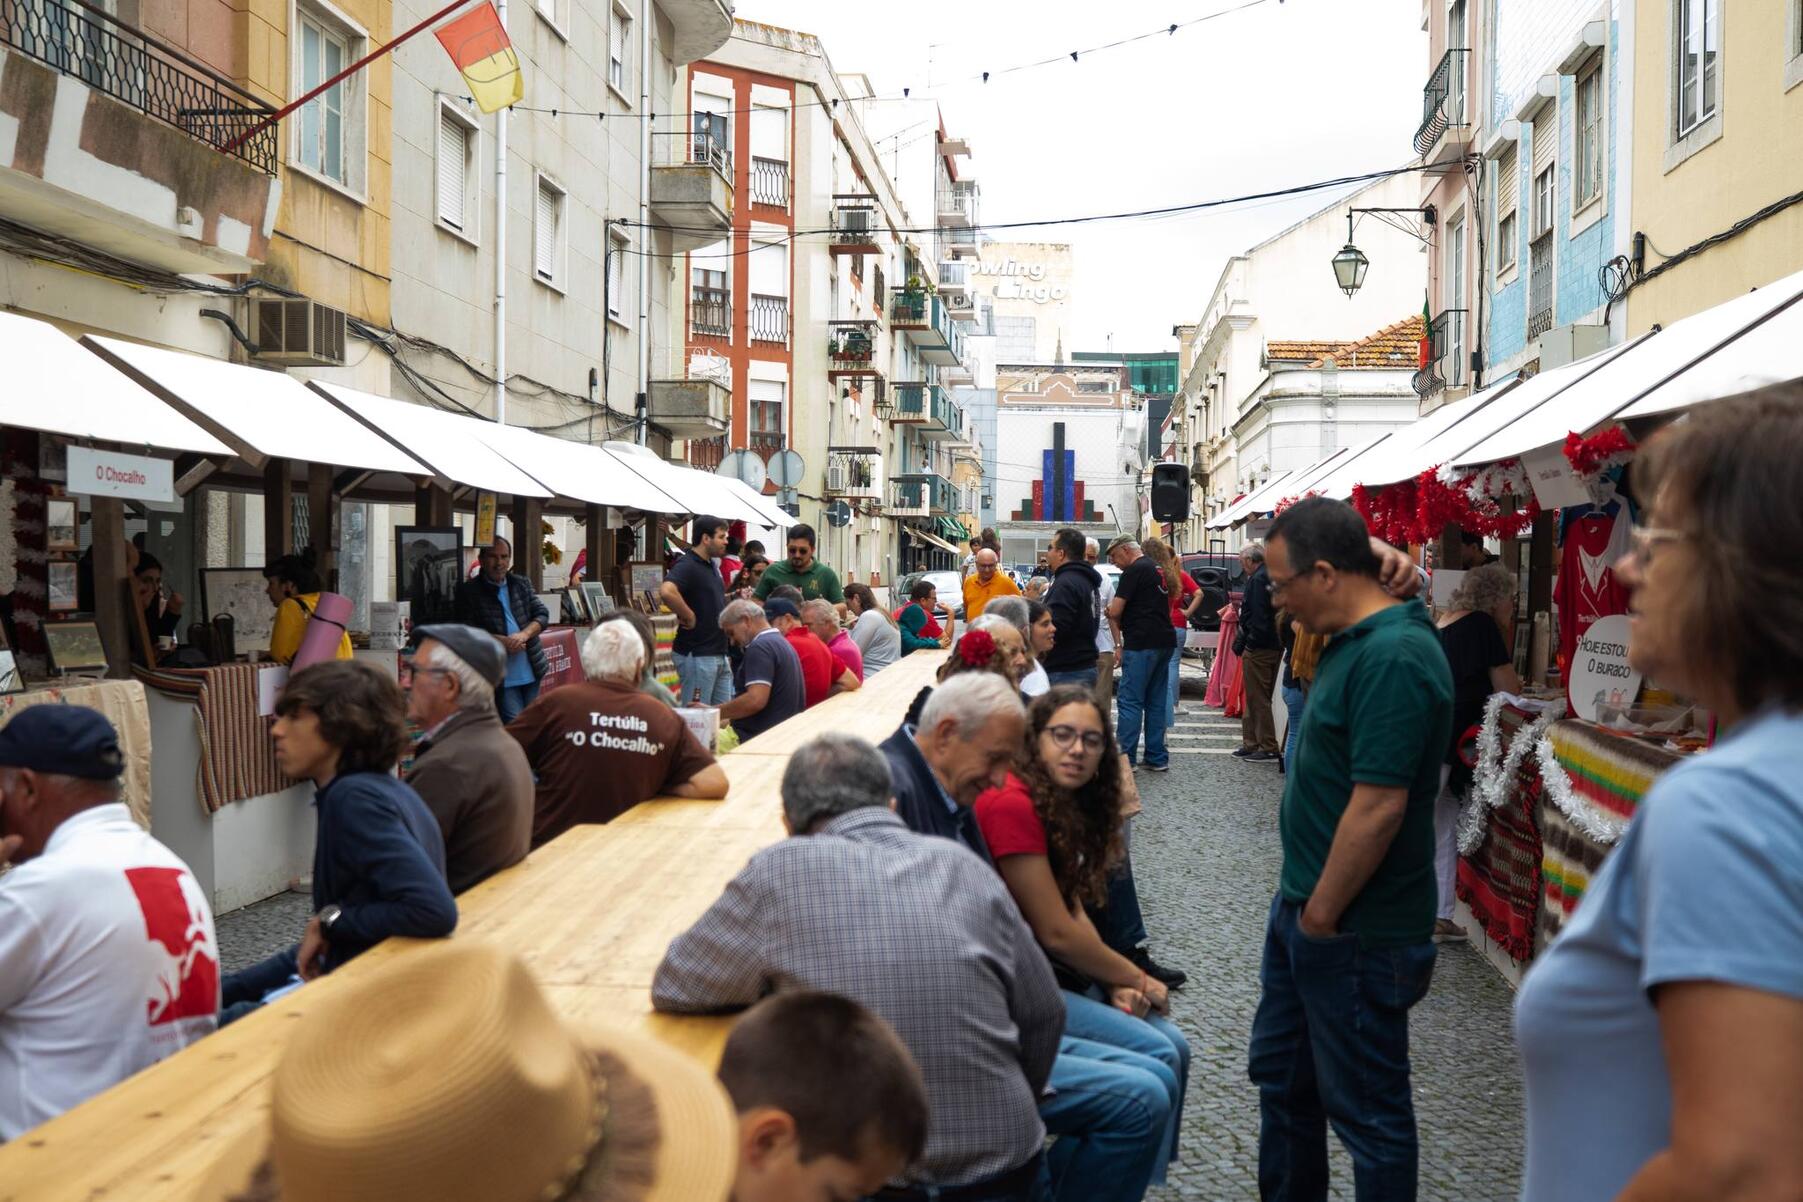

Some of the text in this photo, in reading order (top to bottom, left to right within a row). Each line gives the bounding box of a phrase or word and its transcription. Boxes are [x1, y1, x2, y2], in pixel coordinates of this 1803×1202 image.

[966, 256, 1047, 281] owling
[96, 465, 146, 485] O Chocalho
[1580, 636, 1601, 654] HOJE
[1588, 658, 1596, 673] O
[589, 711, 649, 733] Tertúlia
